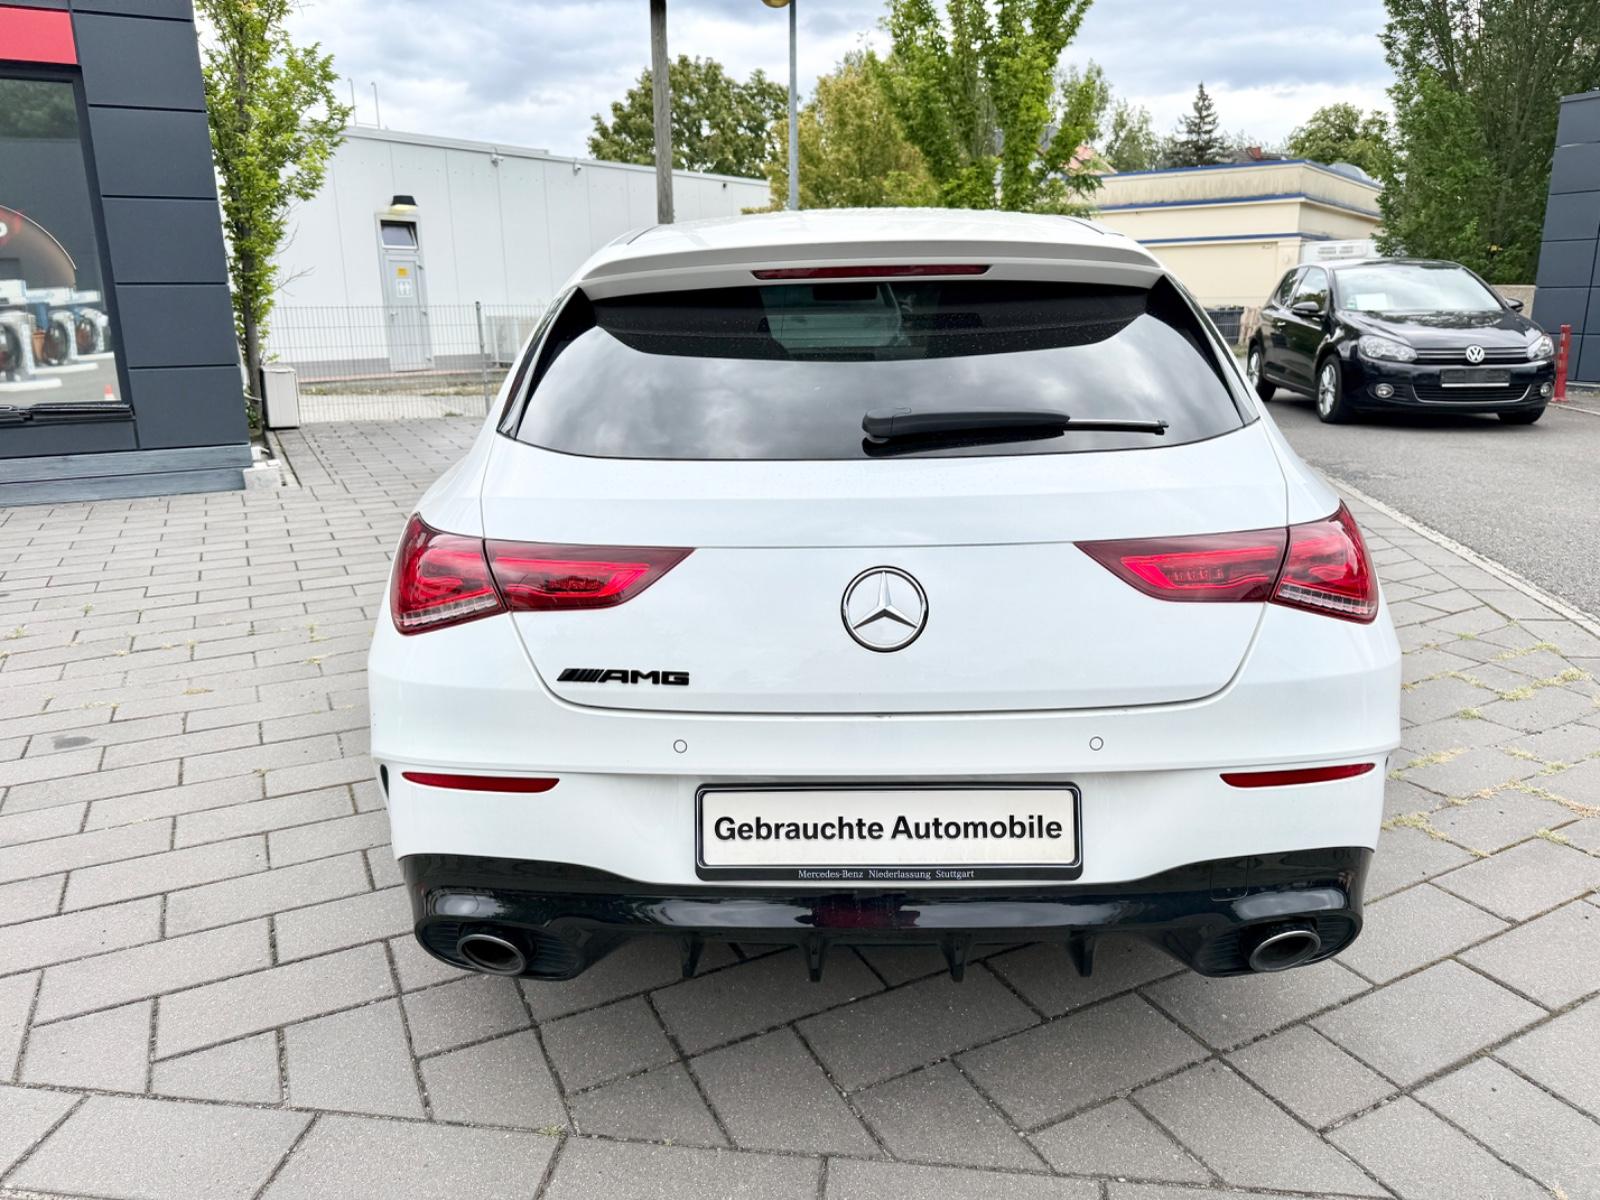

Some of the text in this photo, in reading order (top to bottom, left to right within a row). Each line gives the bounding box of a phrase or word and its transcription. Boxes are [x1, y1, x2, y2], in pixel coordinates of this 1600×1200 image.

[714, 815, 1063, 840] Gebrauchte Automobile
[798, 870, 975, 880] Mercedes-Benz Niederlassung Stuttgart
